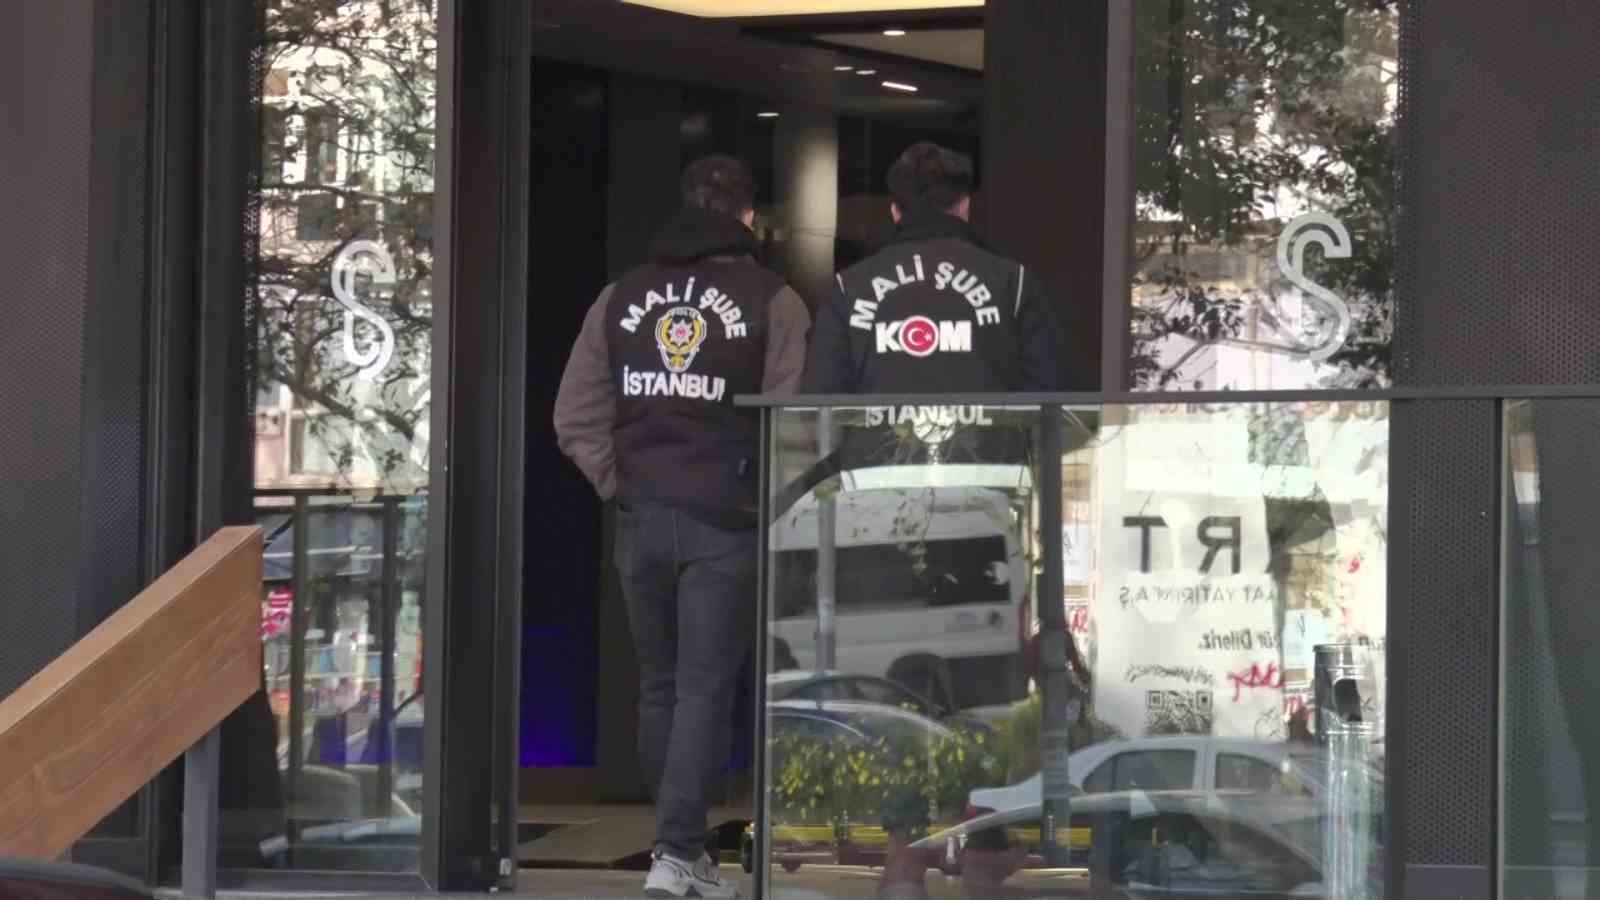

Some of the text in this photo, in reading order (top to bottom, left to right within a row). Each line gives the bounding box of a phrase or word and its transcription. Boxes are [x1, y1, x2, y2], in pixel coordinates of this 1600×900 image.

[619, 276, 748, 340] MALİ ŞUBE
[850, 254, 1001, 331] MALİ ŞUBE
